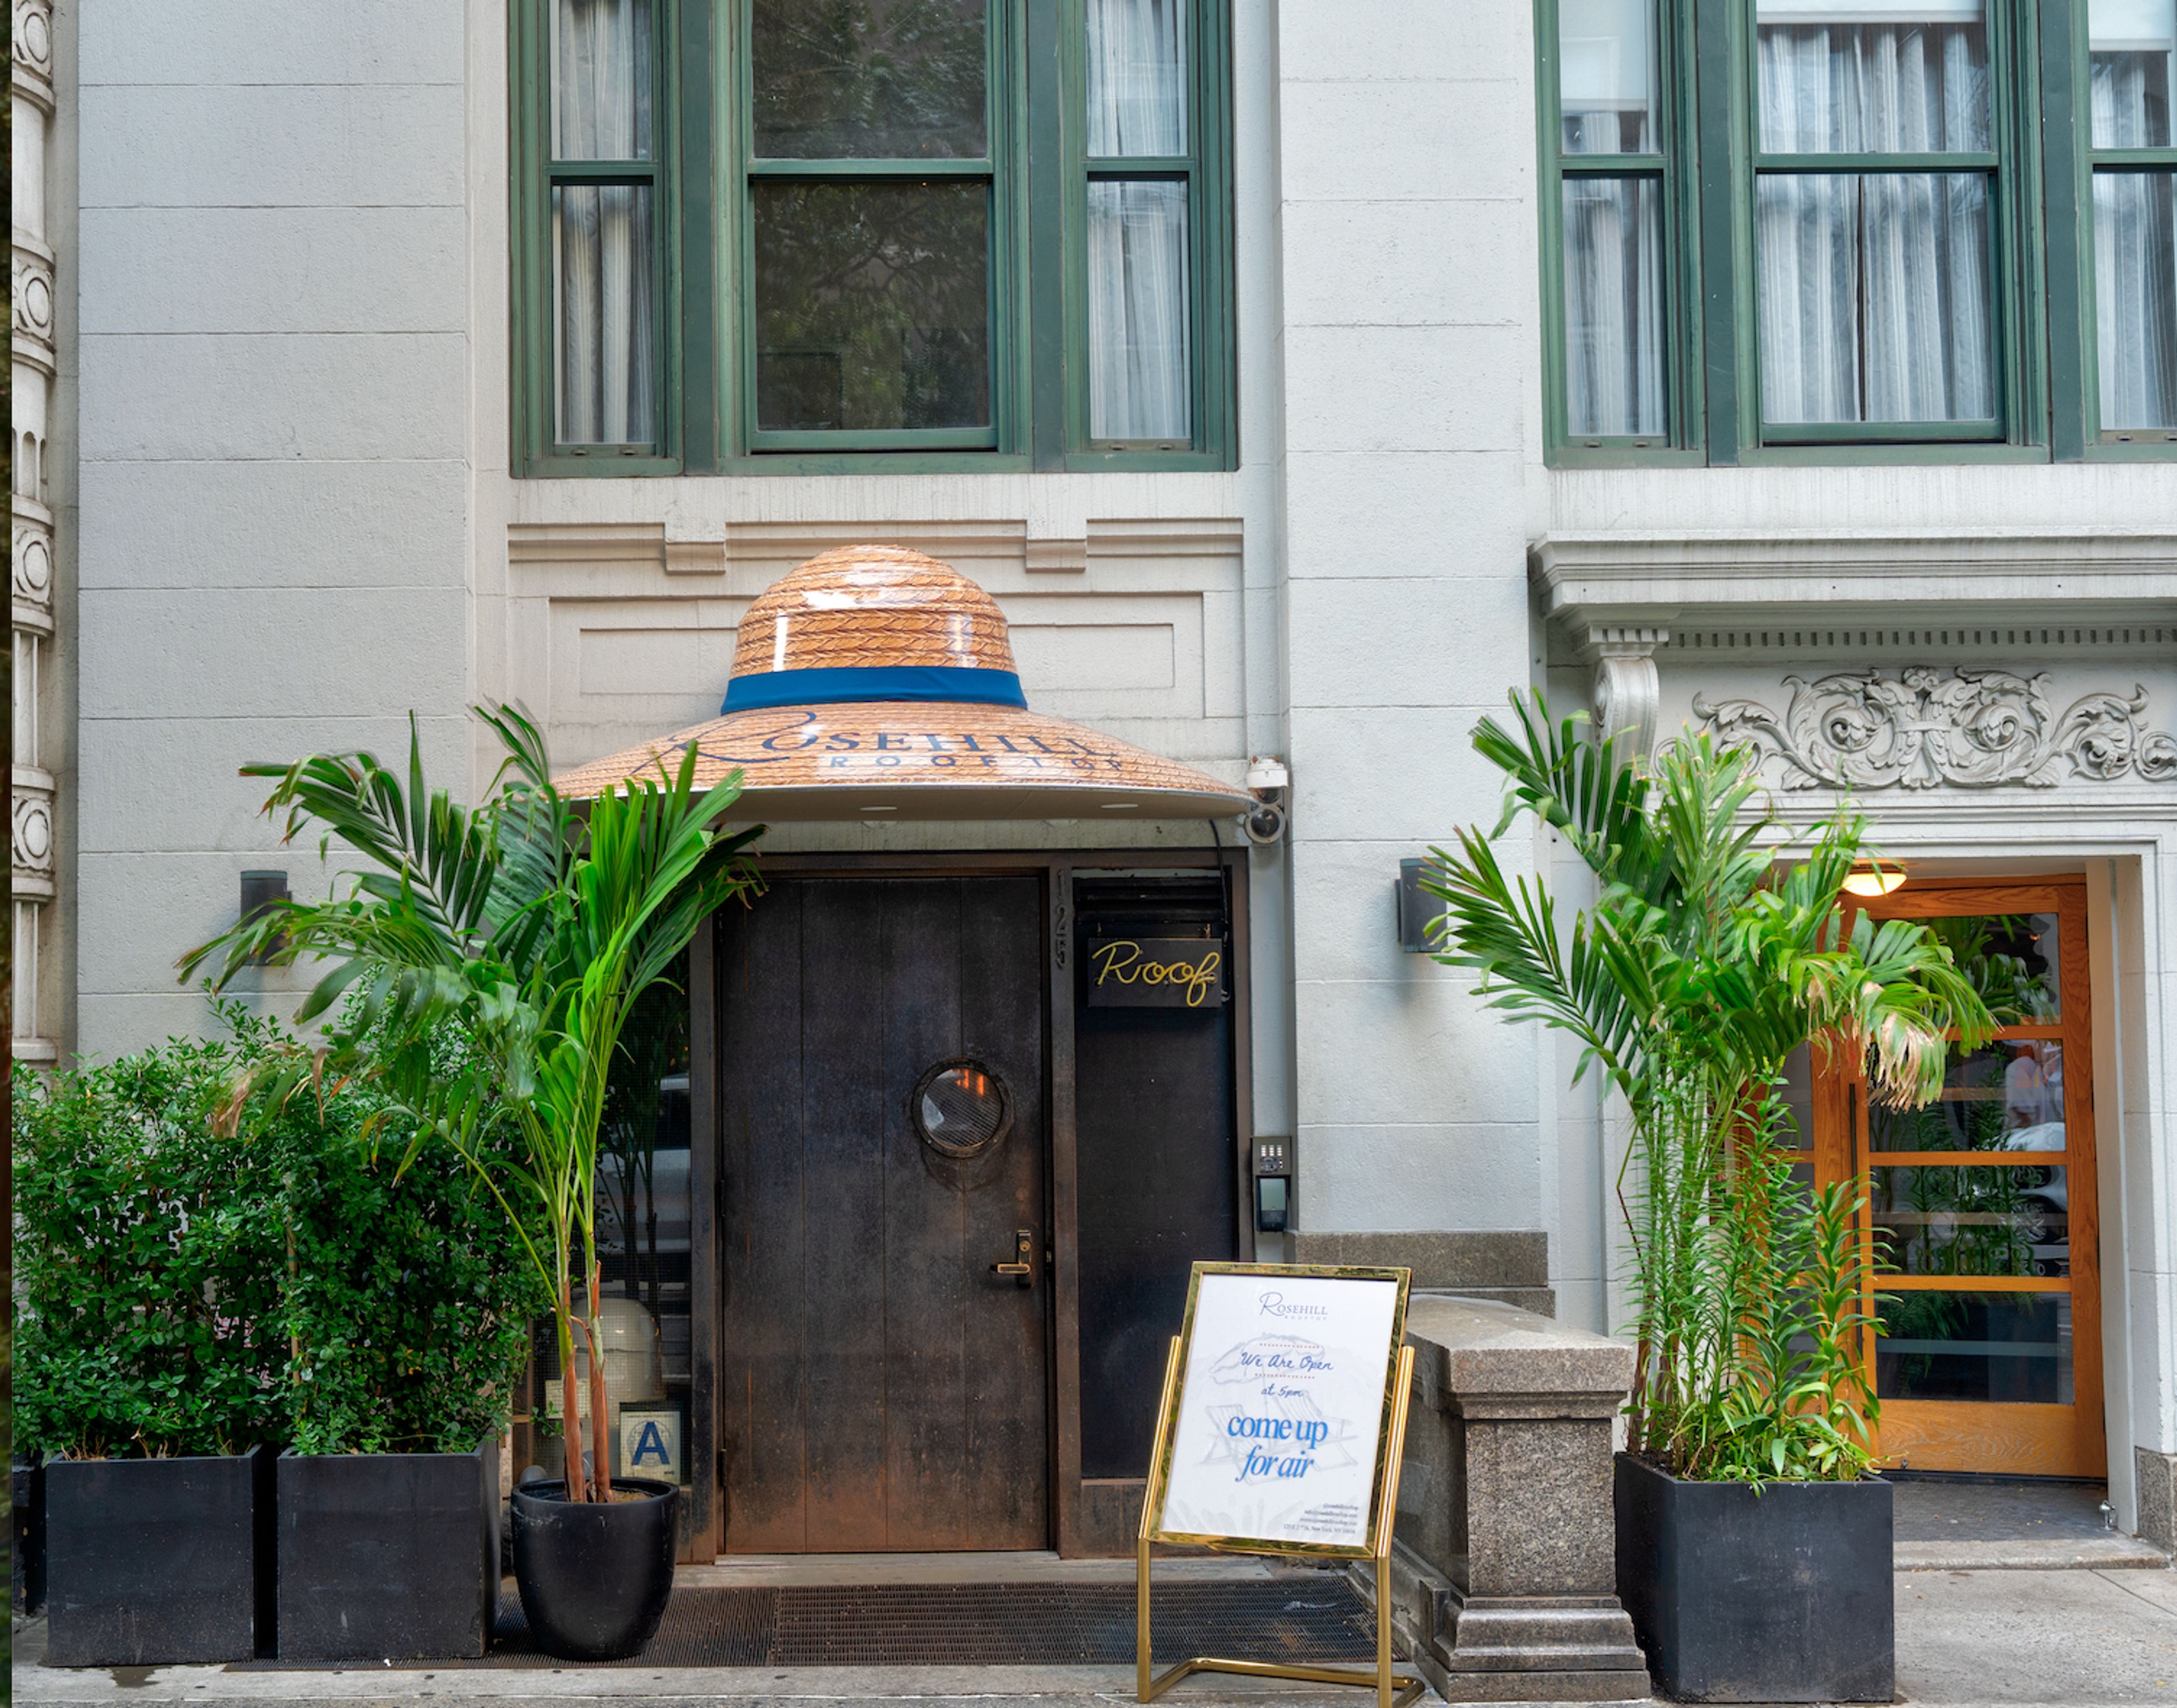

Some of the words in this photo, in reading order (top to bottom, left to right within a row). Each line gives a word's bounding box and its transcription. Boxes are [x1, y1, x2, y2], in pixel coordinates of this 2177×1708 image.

[631, 710, 1117, 775] ROSEHILL
[829, 755, 1123, 771] ROOFTOP
[1055, 869, 1067, 970] 125
[1091, 940, 1220, 1007] Roof
[1259, 1291, 1328, 1316] ROSEHILL
[1240, 1351, 1263, 1367] We
[1268, 1354, 1294, 1368] Are
[1299, 1355, 1334, 1372] Open
[1260, 1383, 1275, 1396] at
[1277, 1385, 1304, 1398] 5pm
[631, 1421, 671, 1465] A
[1227, 1416, 1292, 1439] come
[1296, 1419, 1328, 1450] up
[1235, 1444, 1279, 1482] for
[1277, 1450, 1315, 1478] air
